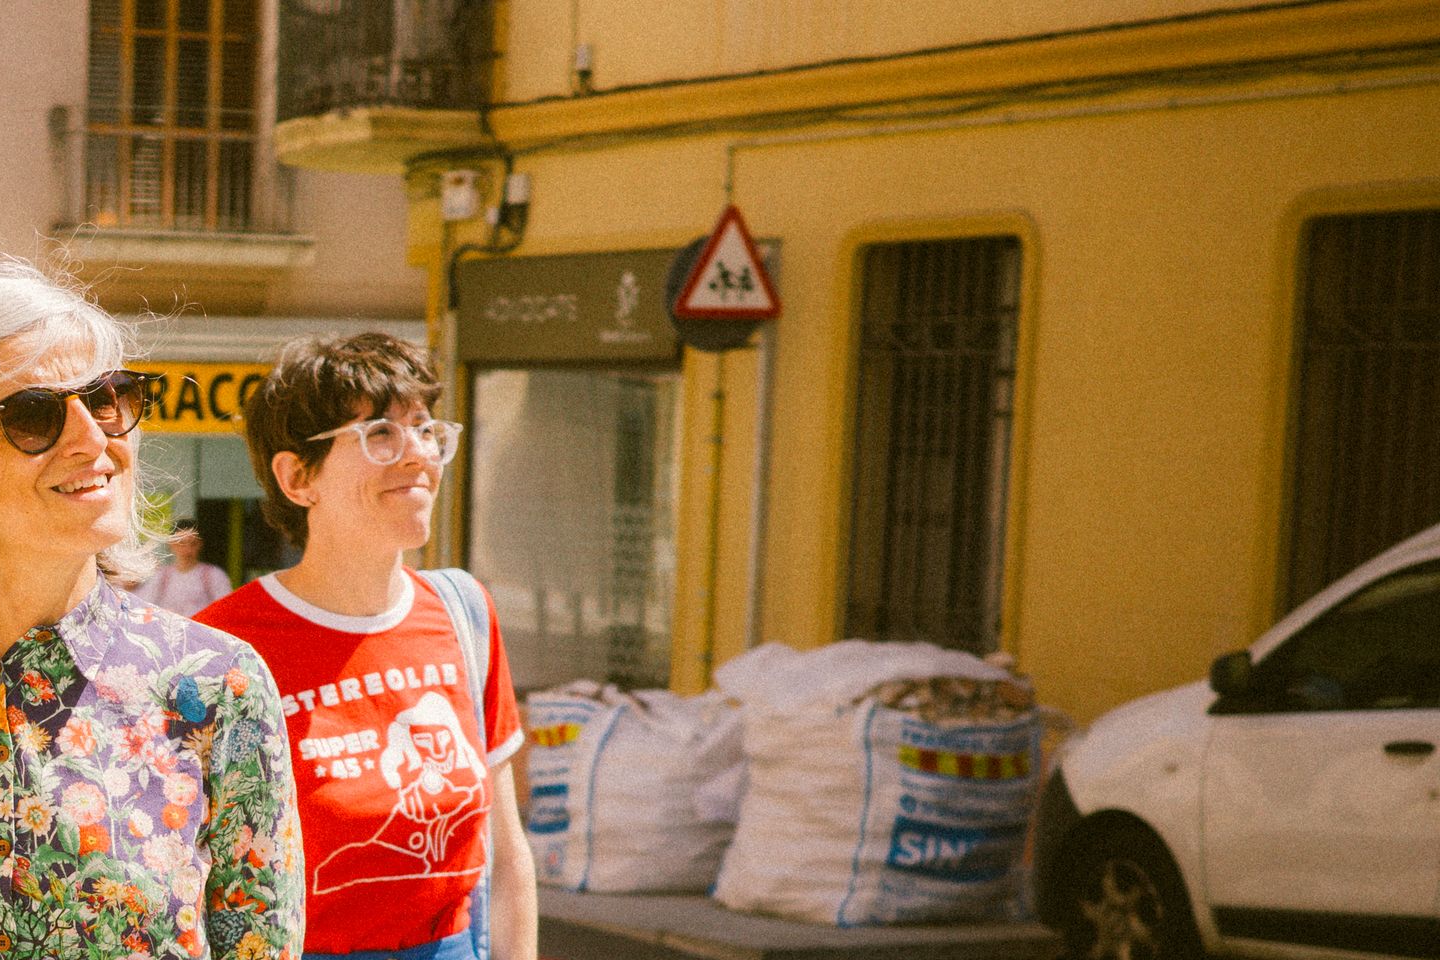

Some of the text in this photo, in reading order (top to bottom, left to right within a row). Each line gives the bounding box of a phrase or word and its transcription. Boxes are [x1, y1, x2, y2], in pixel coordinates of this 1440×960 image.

[282, 663, 457, 717] STEREOLAB
[298, 729, 380, 761] SUPER
[331, 757, 362, 779] 45
[892, 830, 975, 866] SIN
